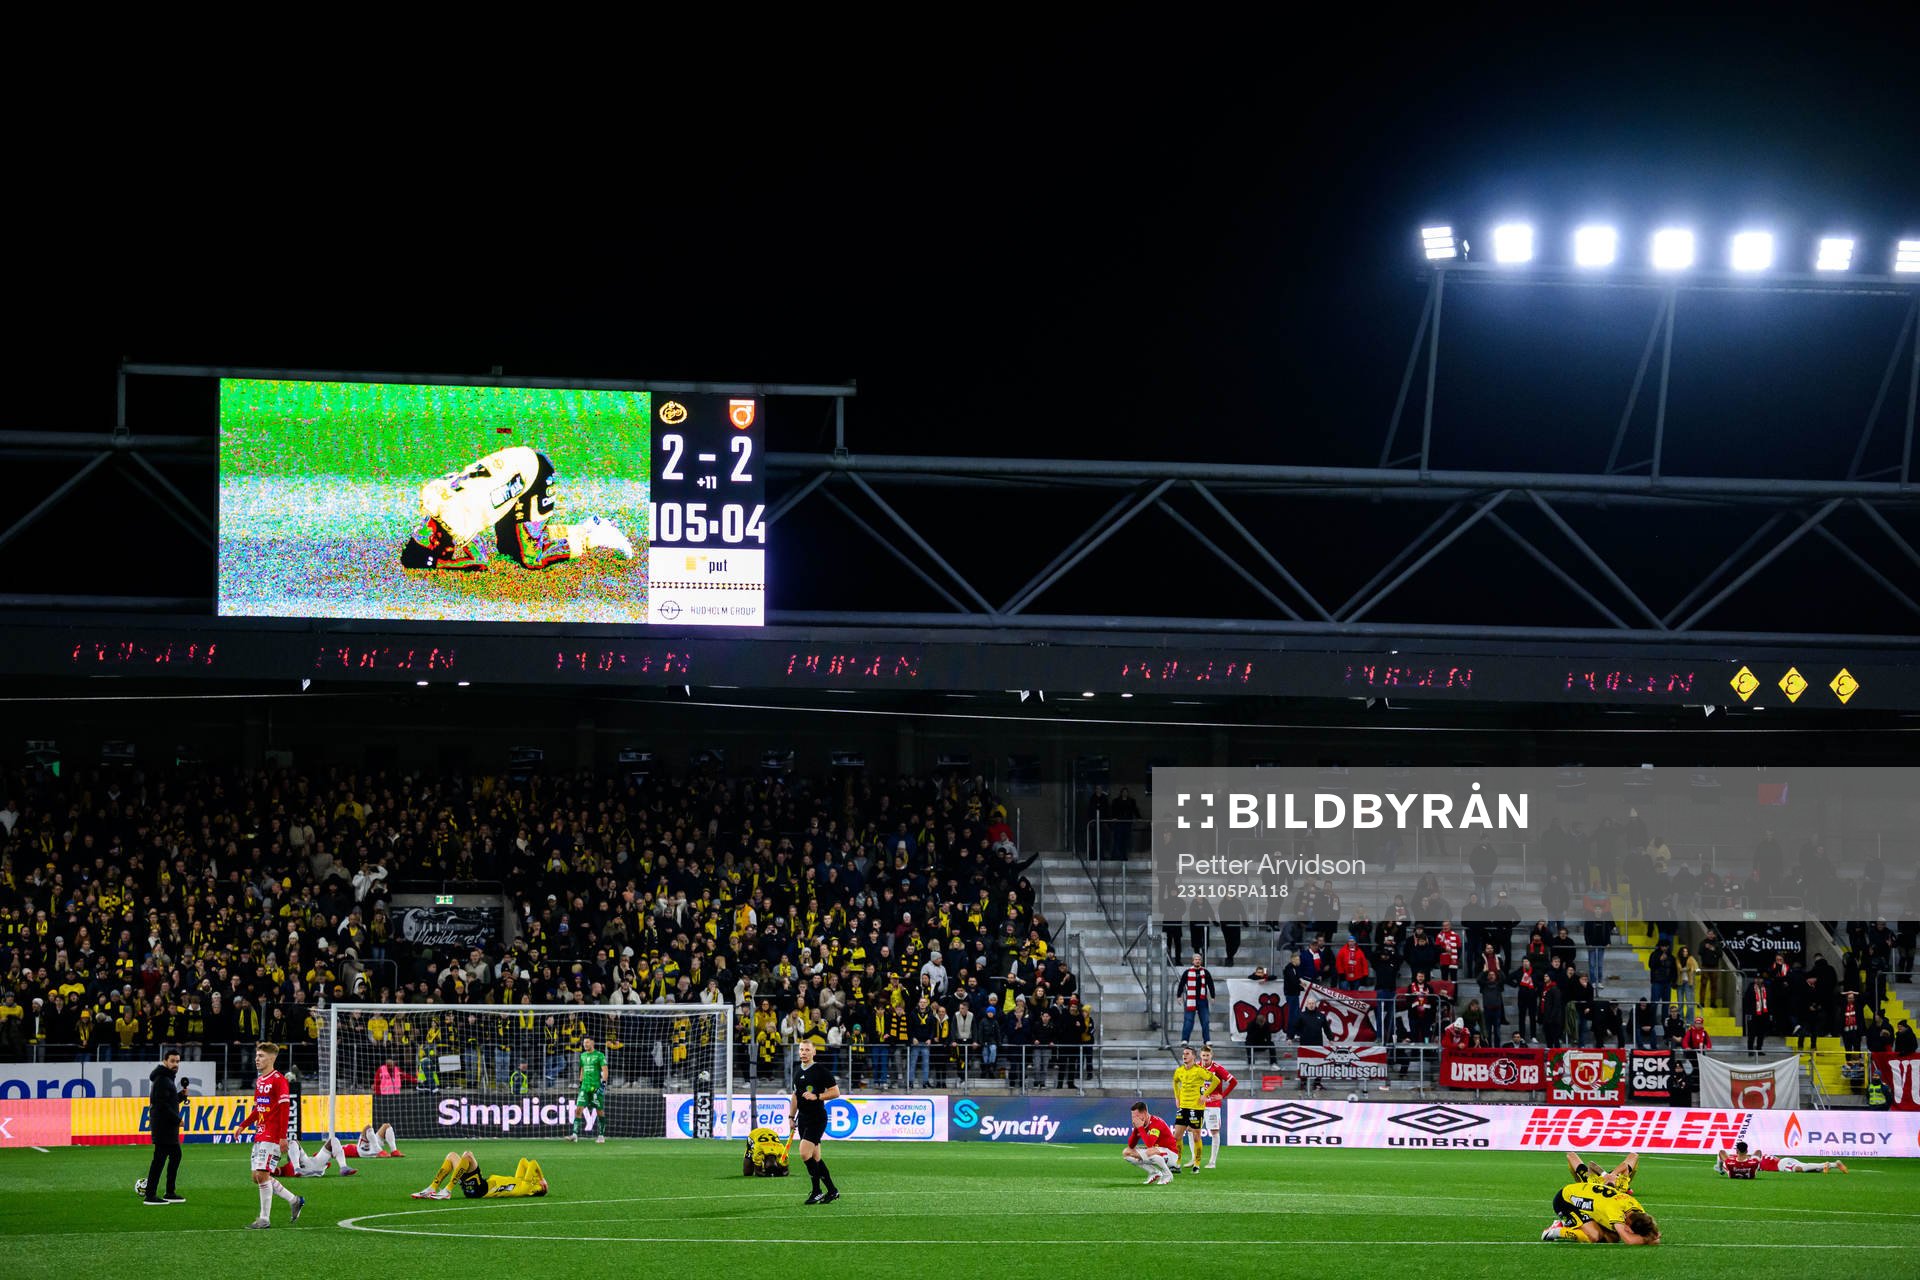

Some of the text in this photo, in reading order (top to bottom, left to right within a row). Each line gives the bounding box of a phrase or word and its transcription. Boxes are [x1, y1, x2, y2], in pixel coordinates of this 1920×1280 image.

[662, 434, 684, 480] 2
[731, 436, 752, 482] 2
[697, 476, 717, 489] +11
[1633, 1058, 1671, 1072] FCK
[1451, 1062, 1539, 1084] URB 03
[1633, 1072, 1670, 1089] ÖSK
[1553, 1089, 1619, 1101] ON TOUR
[438, 1097, 598, 1131] Simplicity
[697, 1092, 711, 1138] SELECT
[862, 1111, 926, 1125] el & tele
[979, 1115, 1060, 1140] Syncify
[1520, 1108, 1746, 1150] MOBILEN
[1241, 1134, 1342, 1146] UMBRO
[1388, 1136, 1489, 1148] UMBRO
[1808, 1131, 1893, 1145] PAROY
